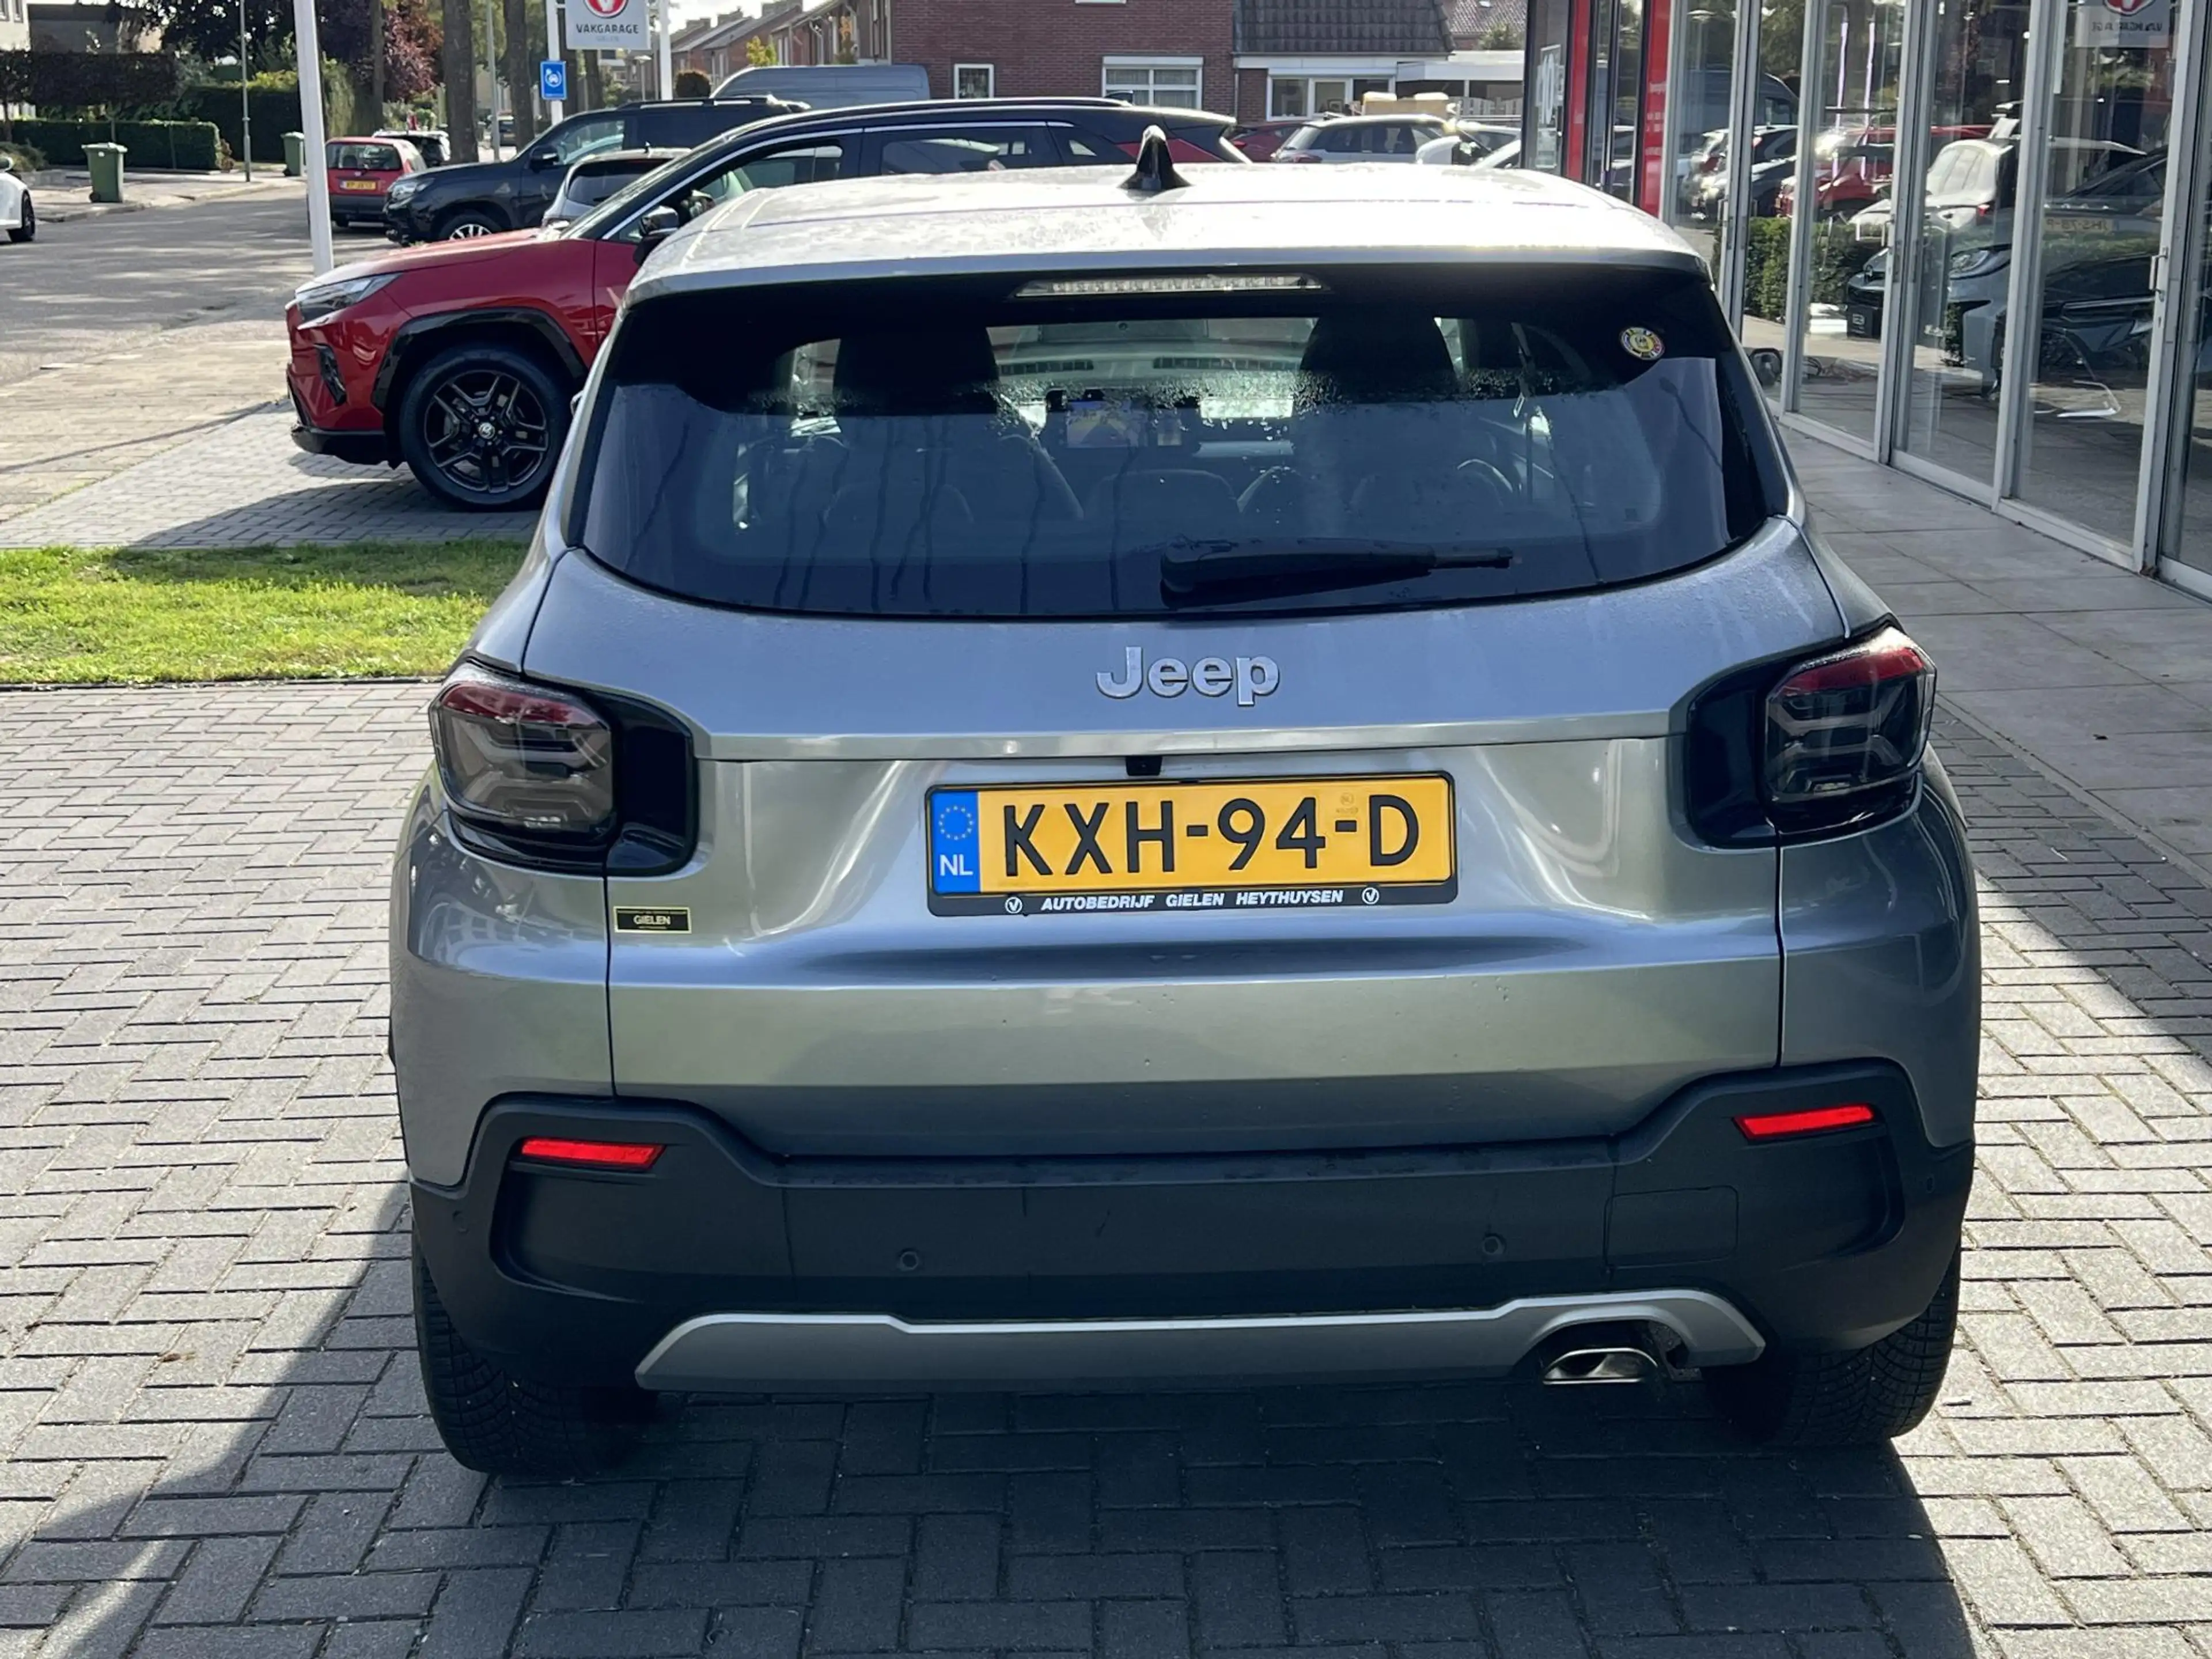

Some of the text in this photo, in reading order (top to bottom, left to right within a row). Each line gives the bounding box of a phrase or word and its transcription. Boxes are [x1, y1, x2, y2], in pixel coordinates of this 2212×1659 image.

[576, 24, 639, 34] VAKGARAGE
[1096, 646, 1280, 707] Jeep
[1004, 794, 1419, 877] KXH-94-D
[940, 853, 974, 876] NL
[1040, 895, 1155, 911] AUTOBEDRIJF
[1166, 893, 1225, 907] GIELEN
[1236, 889, 1344, 906] HEYTHUYSEN
[633, 915, 671, 925] GIELEN
